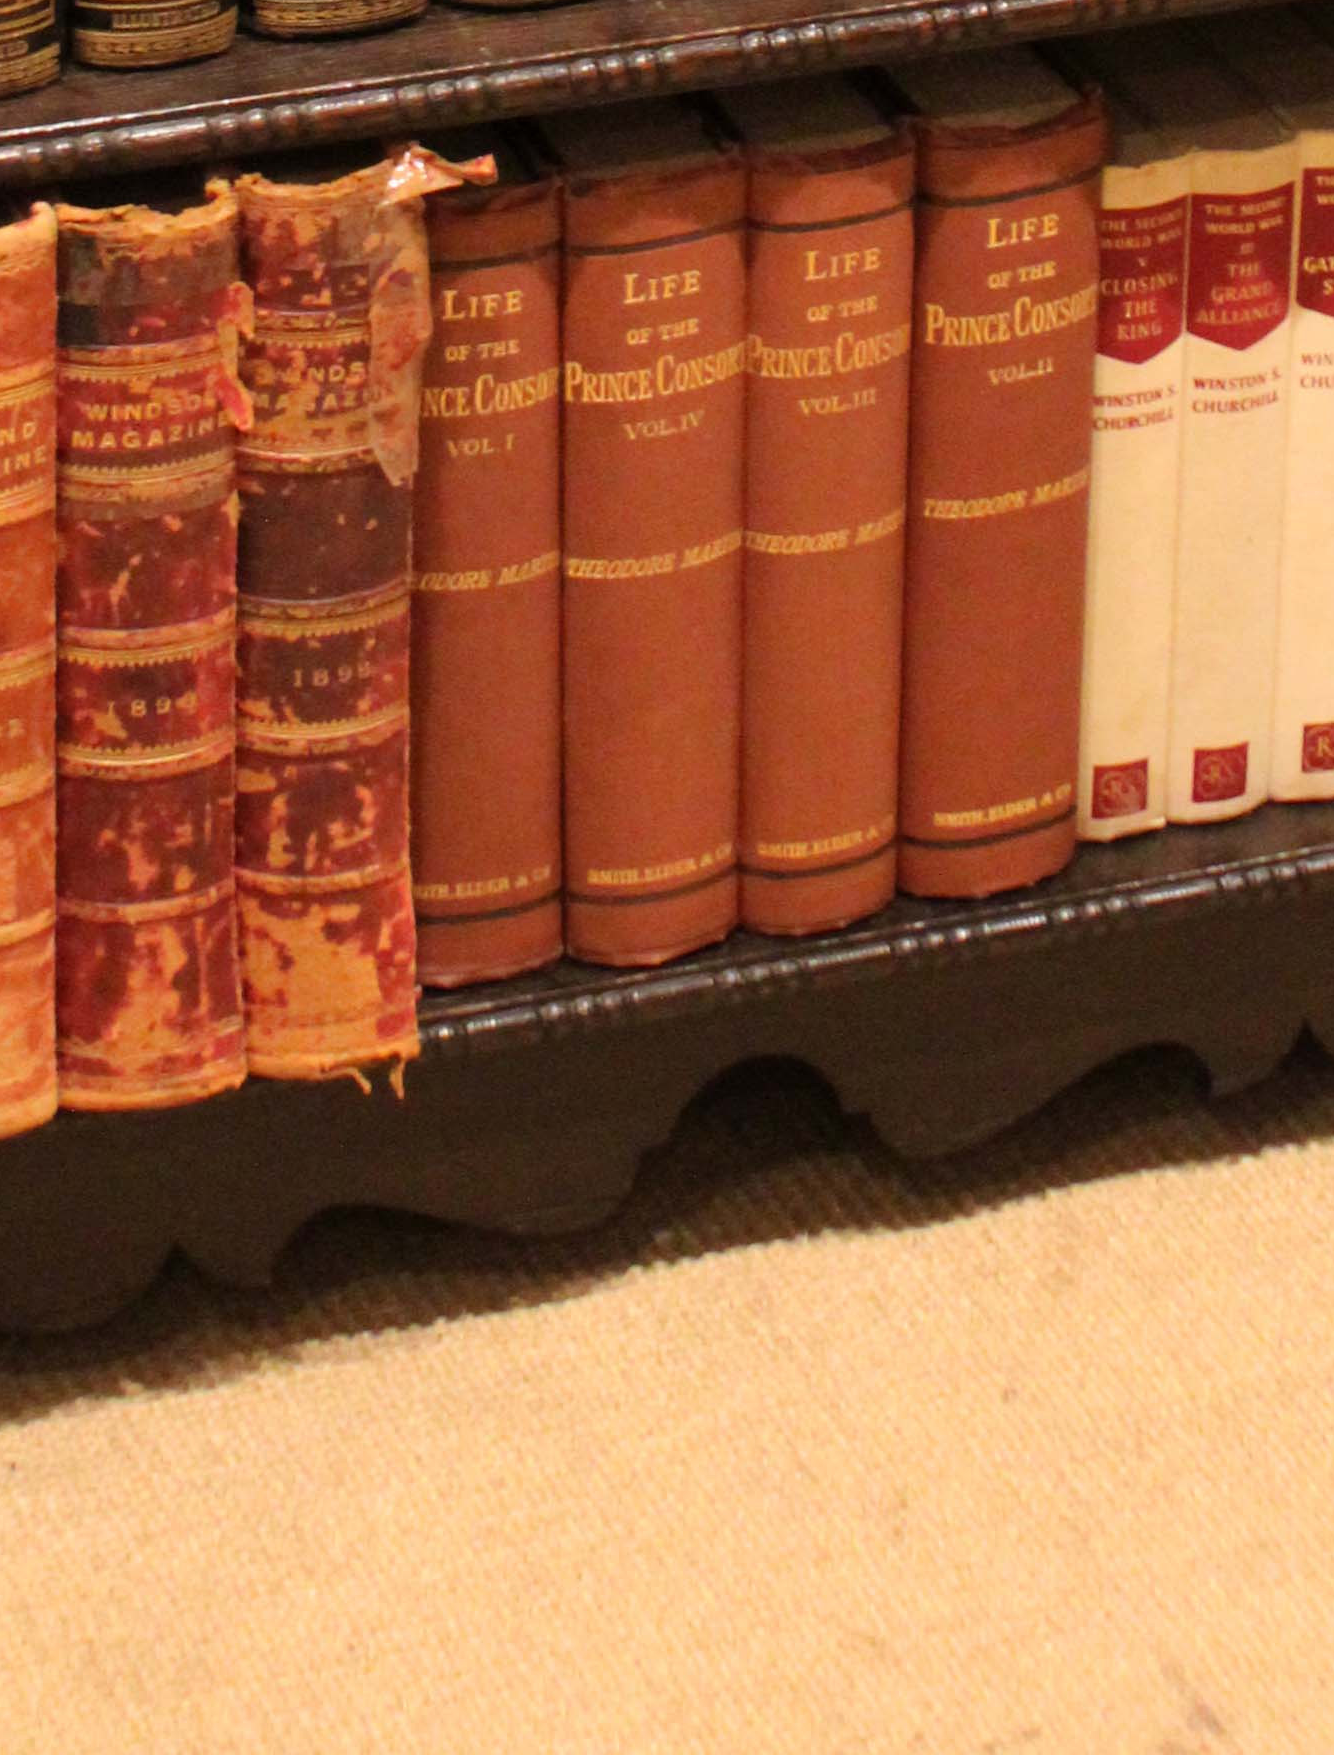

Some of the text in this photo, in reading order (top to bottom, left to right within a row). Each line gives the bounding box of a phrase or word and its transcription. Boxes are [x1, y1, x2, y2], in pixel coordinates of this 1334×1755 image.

[987, 214, 1060, 249] LIFE
[804, 248, 883, 282] LIFE
[987, 260, 1058, 290] OF THE
[623, 270, 702, 305] LIFE
[442, 289, 524, 320] LIFE
[807, 295, 879, 322] OF THE
[1122, 299, 1158, 319] THE
[626, 319, 700, 345] OF THE
[925, 302, 1011, 347] PRINCE
[1117, 321, 1163, 341] RING
[445, 339, 520, 363] OF THE
[749, 334, 831, 379] PRINCE
[565, 360, 653, 403] PRINCE
[1193, 374, 1267, 391] WINSTON
[1191, 390, 1279, 414] CHURCHILL
